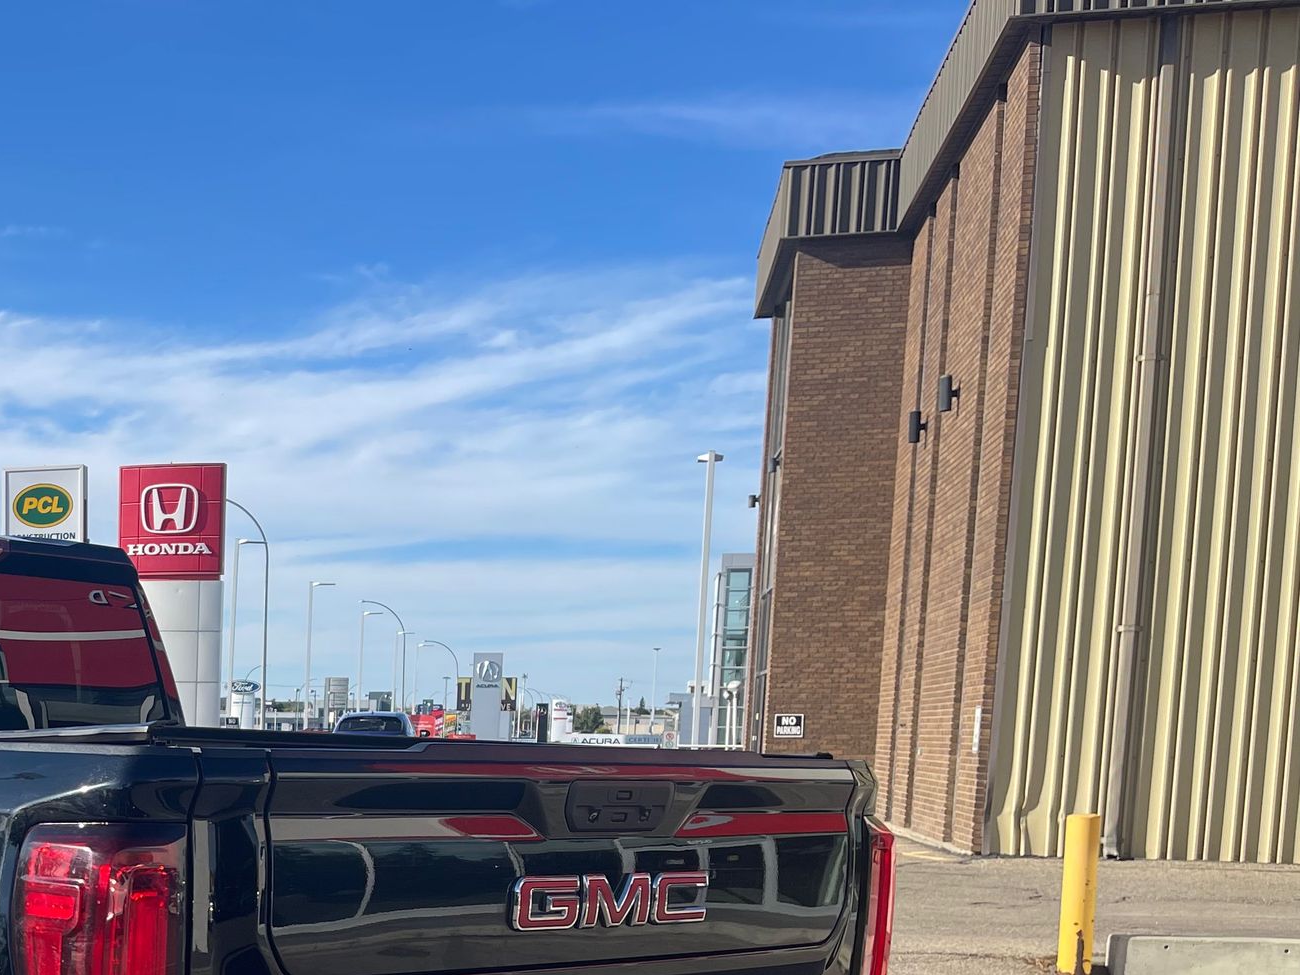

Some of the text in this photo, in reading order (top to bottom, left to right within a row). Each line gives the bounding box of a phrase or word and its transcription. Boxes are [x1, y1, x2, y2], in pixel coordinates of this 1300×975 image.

[22, 495, 64, 515] PCL
[13, 532, 76, 540] TRUCTION
[127, 542, 212, 556] HONDA
[232, 682, 254, 692] Ford
[781, 716, 797, 726] NO
[512, 870, 709, 931] GMC
